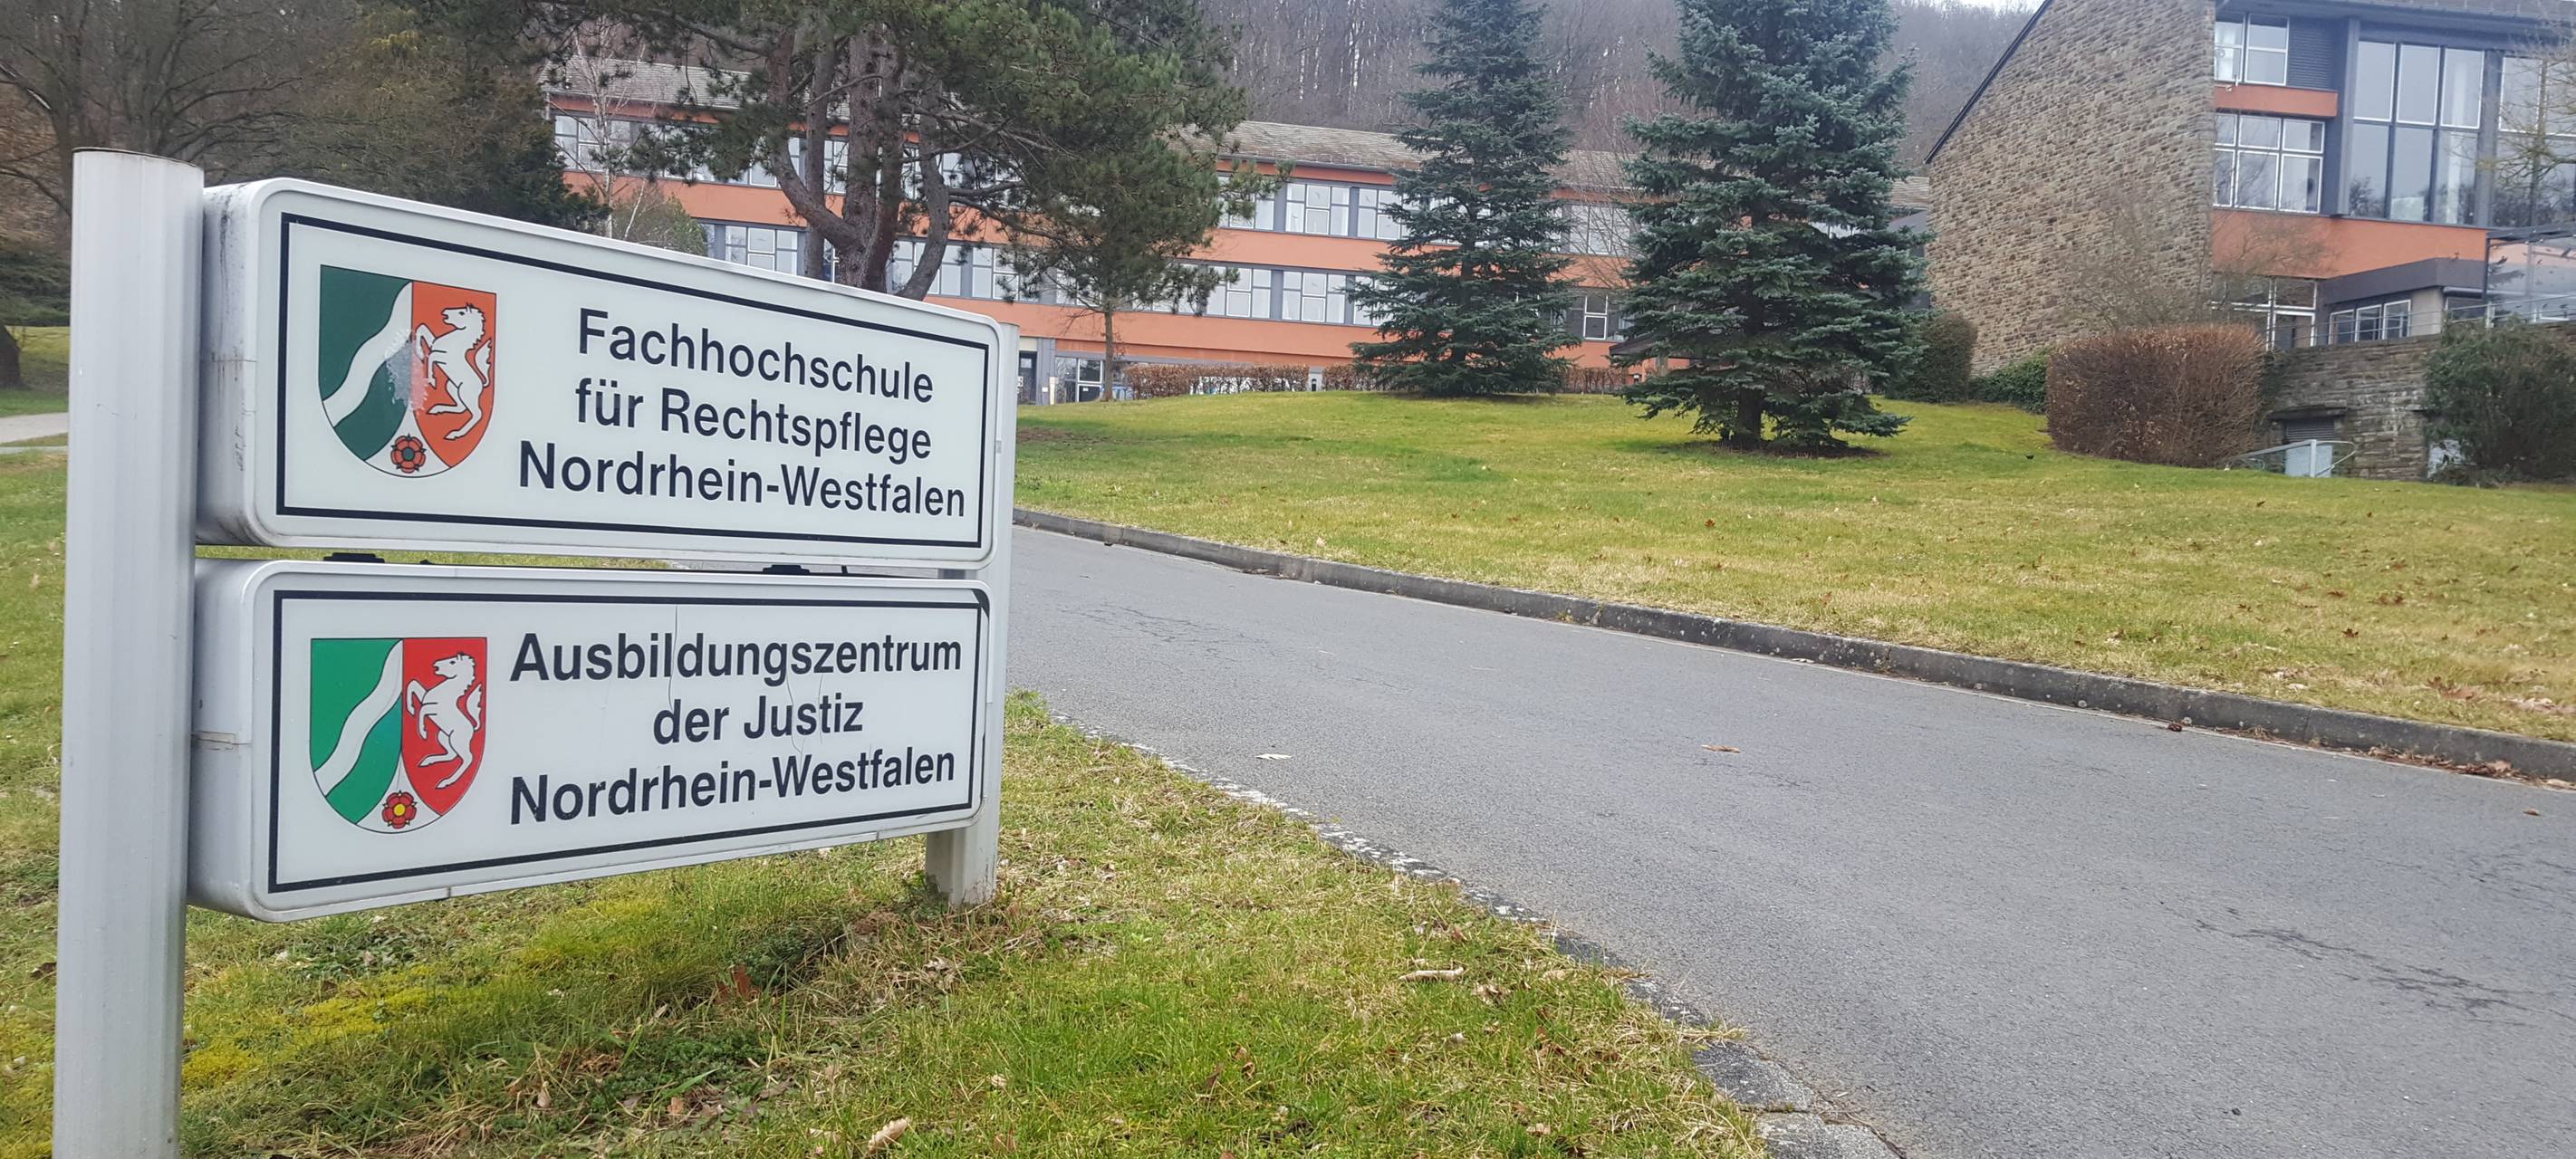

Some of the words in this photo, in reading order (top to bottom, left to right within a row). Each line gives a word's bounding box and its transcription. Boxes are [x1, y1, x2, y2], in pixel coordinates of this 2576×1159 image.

[578, 308, 933, 402] Fachhochschule
[575, 378, 644, 428] für
[660, 387, 931, 464] Rechtspflege
[519, 440, 965, 516] Nordrhein-Westfalen
[509, 633, 962, 686] Ausbildungszentrum
[652, 698, 730, 744] der
[744, 692, 863, 740] Justiz
[510, 747, 954, 824] Nordrhein-Westfalen
